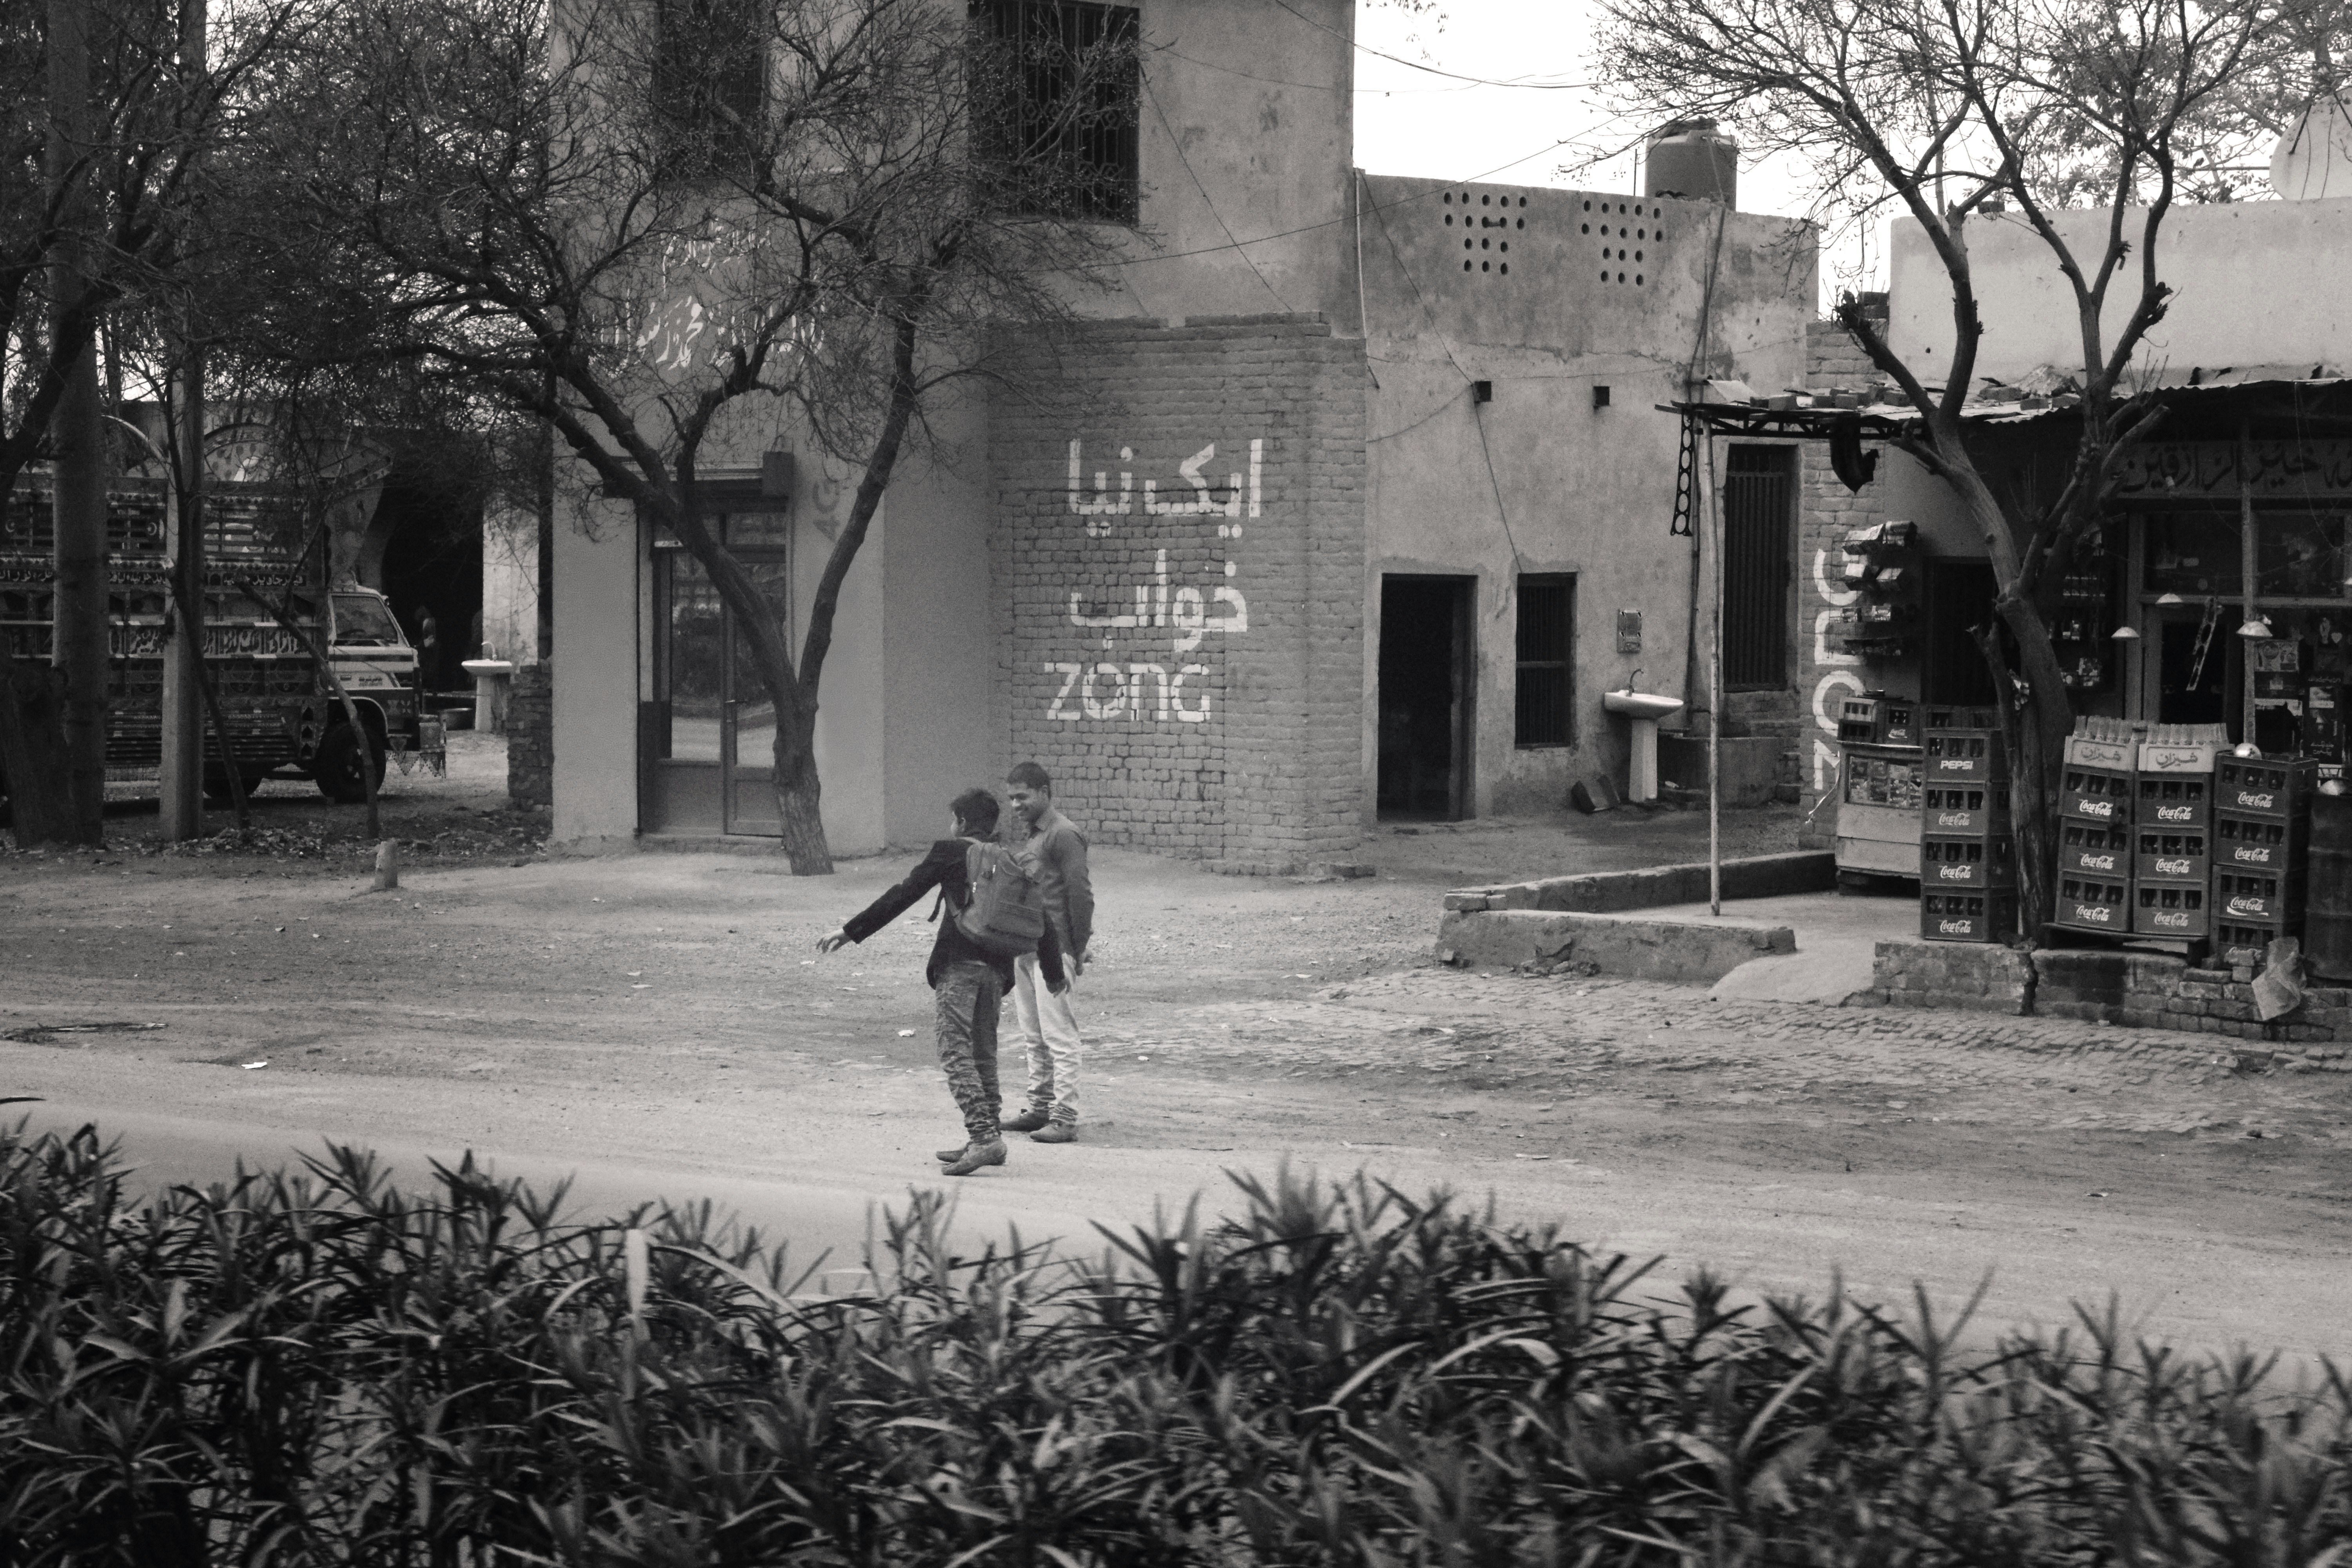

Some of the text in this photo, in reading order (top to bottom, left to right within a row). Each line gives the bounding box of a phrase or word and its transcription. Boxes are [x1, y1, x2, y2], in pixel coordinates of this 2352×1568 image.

[1068, 439, 1262, 538] ایک نیا
[1071, 549, 1247, 652] خواب
[1940, 760, 1974, 770] PEPSI
[2155, 751, 2198, 769] شیزان
[2079, 799, 2113, 816] Coca-Cola
[2237, 791, 2274, 808] Coca-Cola
[1938, 813, 1971, 826] Coca-Cola
[2157, 806, 2192, 820] Coca-Cola
[2080, 853, 2115, 869] Coca-Cola
[2235, 846, 2270, 862] Coca-Cola
[1940, 865, 1971, 878] Coca-Cola
[2155, 858, 2191, 873] Coca-Cola
[2230, 896, 2265, 911] Coca-Cola
[2076, 905, 2110, 922] Coca-Cola
[2154, 911, 2189, 927] Coca-Cola
[1940, 920, 1972, 933] Coca-Cola
